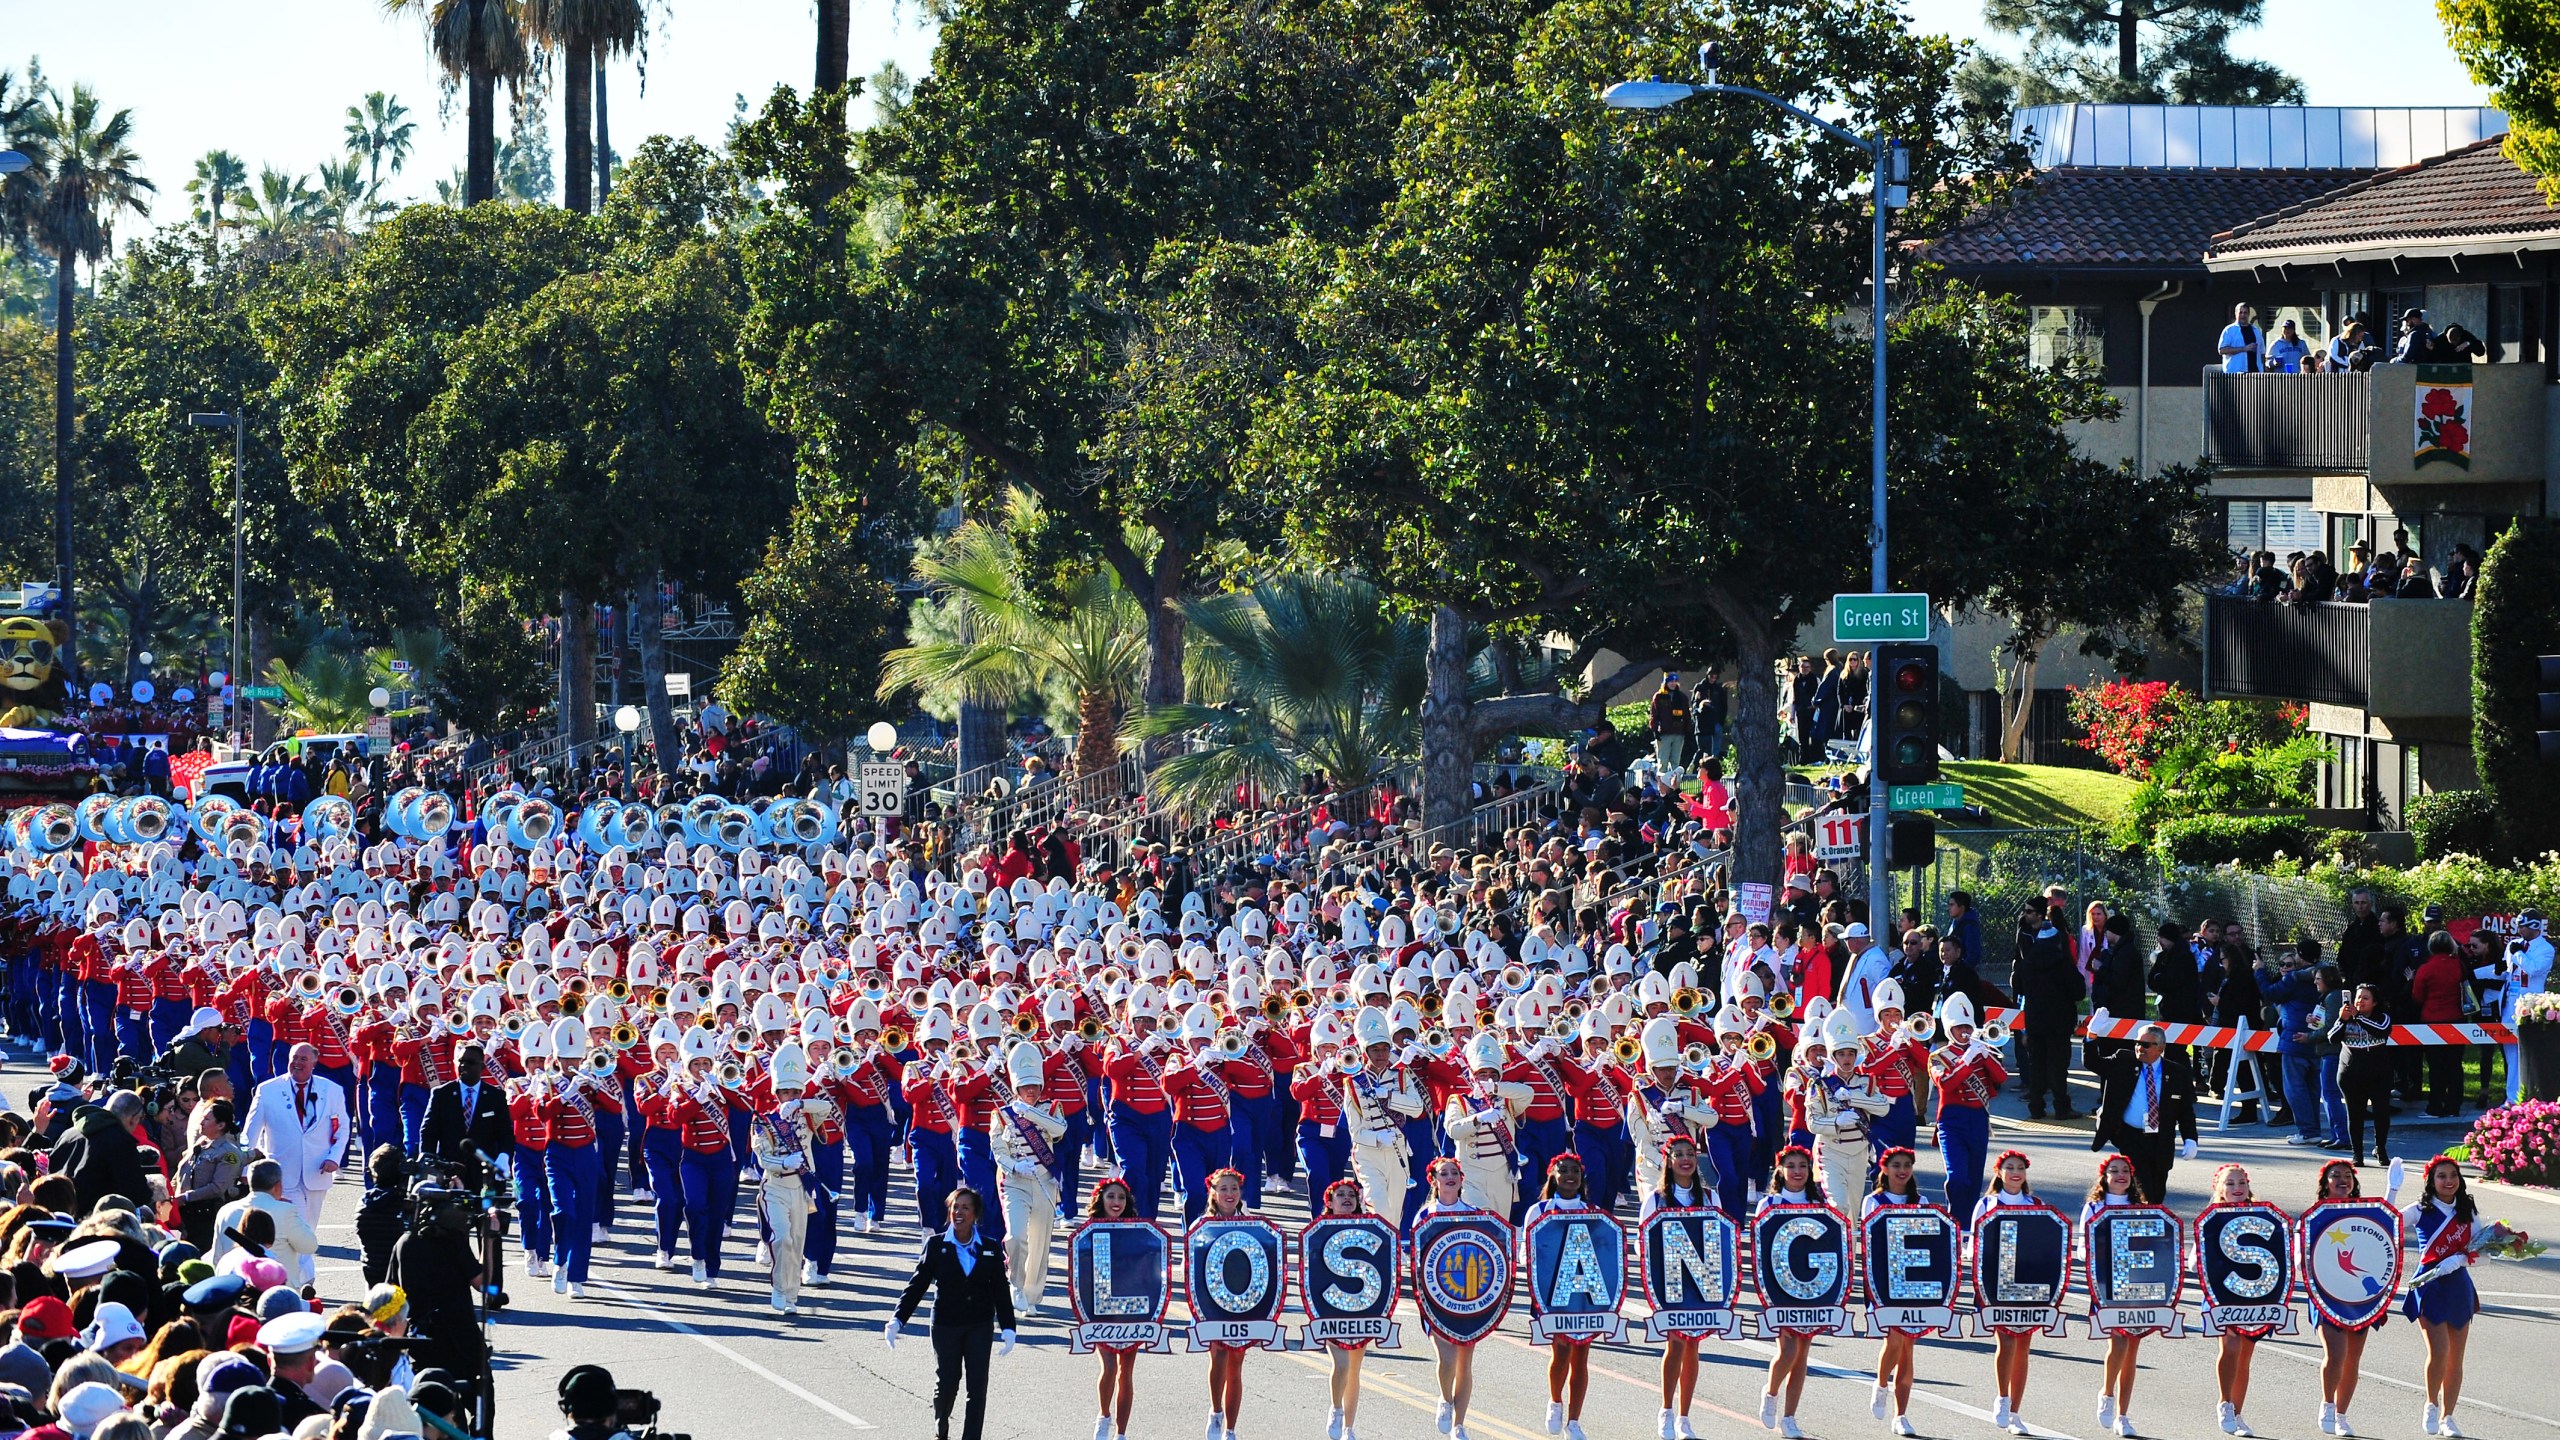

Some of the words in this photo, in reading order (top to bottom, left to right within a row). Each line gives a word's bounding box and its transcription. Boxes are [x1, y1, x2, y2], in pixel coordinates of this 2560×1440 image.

[1843, 609, 1892, 627] Green
[1901, 609, 1919, 626] St
[393, 661, 406, 669] 151
[257, 688, 274, 696] Rosa
[863, 767, 901, 777] SPEED
[867, 780, 897, 788] LIMIT
[865, 791, 898, 811] 30
[1895, 787, 1934, 805] Green
[1821, 847, 1828, 855] S.
[1828, 846, 1853, 855] Orange
[2472, 1029, 2496, 1038] CITY
[1598, 1077, 1621, 1109] NGELES
[1445, 1231, 1472, 1243] UNIFIED
[2351, 1225, 2384, 1242] BEYOND
[1474, 1234, 1497, 1254] SCHOOL
[2383, 1241, 2394, 1260] THE
[1427, 1240, 1446, 1268] ANGELES
[1662, 1219, 1724, 1303] N
[1770, 1217, 1838, 1300] G
[1886, 1217, 1943, 1300] E
[1999, 1220, 2051, 1302] L
[2111, 1219, 2166, 1301] E
[2219, 1217, 2279, 1298] S
[1092, 1232, 1150, 1315] L
[1205, 1230, 1269, 1314] O
[1322, 1228, 1383, 1312] S
[1494, 1253, 1505, 1284] DISTRICT
[1551, 1223, 1611, 1306] A
[2381, 1261, 2394, 1281] BELL
[1426, 1270, 1434, 1283] LOS
[1435, 1292, 1445, 1304] ALL
[1446, 1301, 1476, 1311] DISTRICT
[1478, 1293, 1495, 1308] BAND
[1555, 1314, 1604, 1330] UNIFIED
[1667, 1311, 1721, 1327] SCHOOL
[1776, 1308, 1835, 1324] DISTRICT
[1900, 1308, 1927, 1324] ALL
[1993, 1308, 2049, 1324] DISTRICT
[2118, 1310, 2157, 1325] BAND
[2216, 1306, 2282, 1324] LAUSD
[1085, 1324, 1154, 1340] LAUSD
[1222, 1323, 1249, 1338] LOS
[1320, 1319, 1382, 1336] ANGELES
